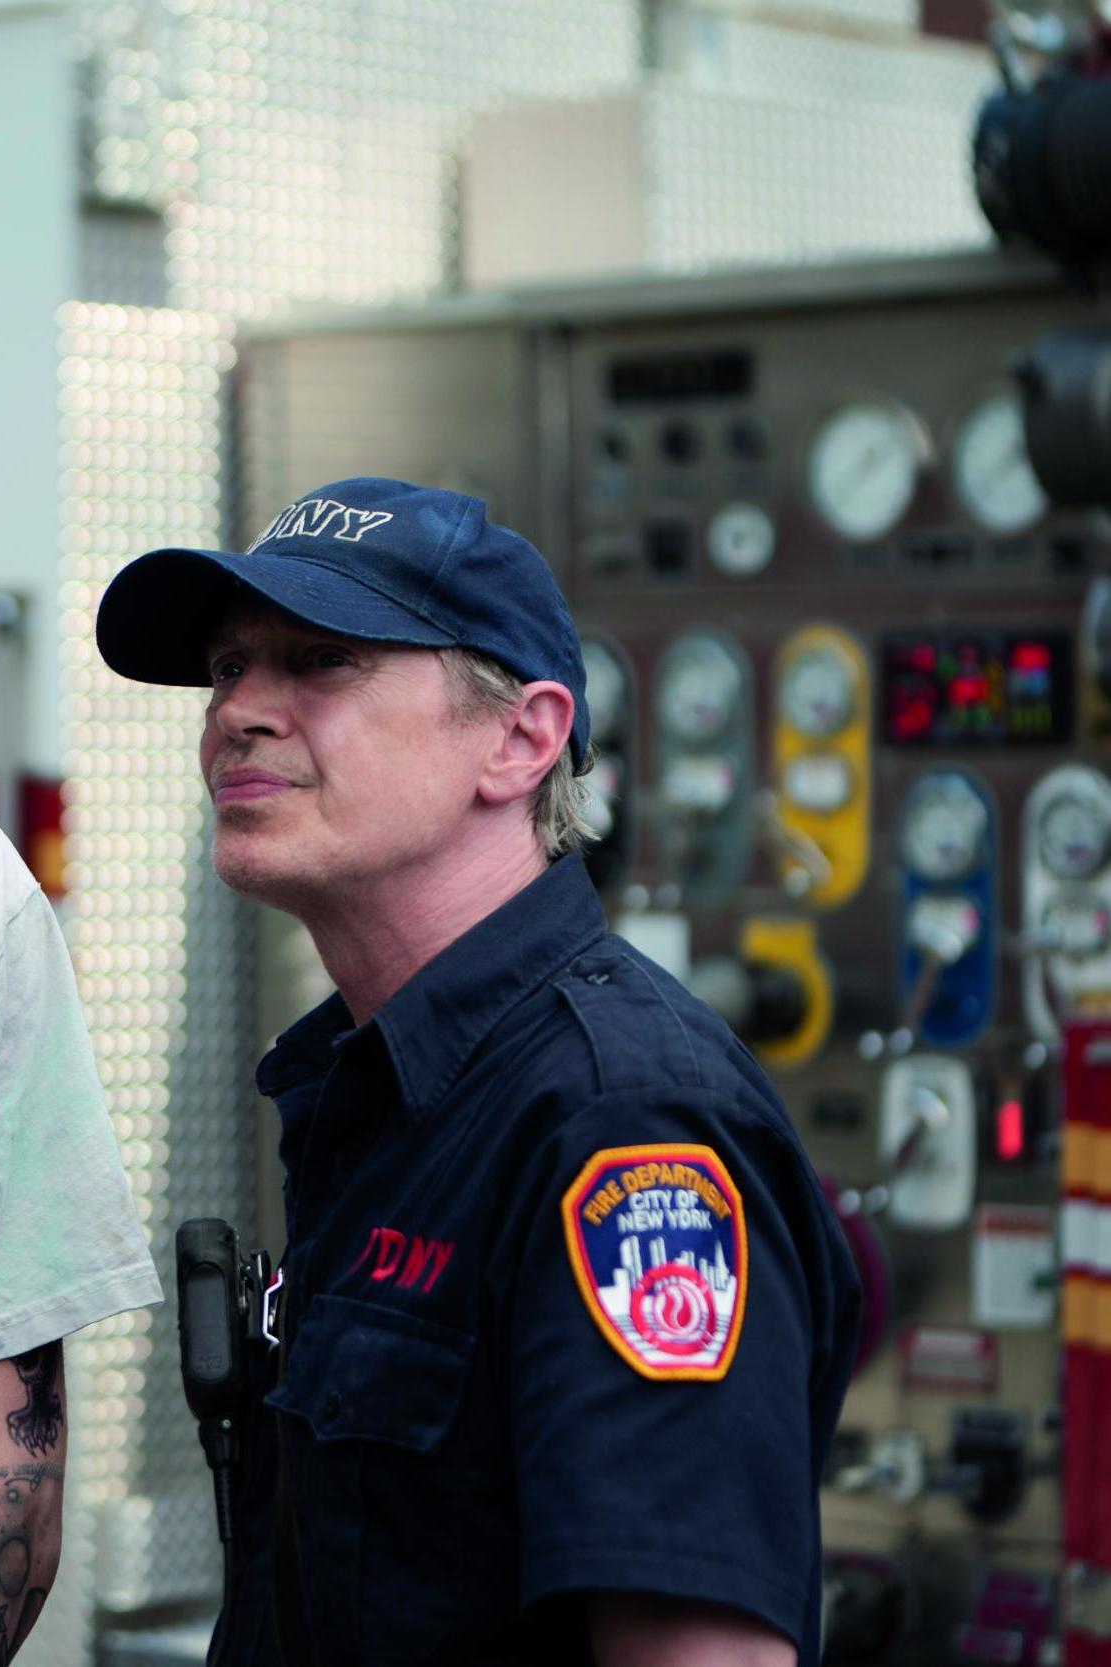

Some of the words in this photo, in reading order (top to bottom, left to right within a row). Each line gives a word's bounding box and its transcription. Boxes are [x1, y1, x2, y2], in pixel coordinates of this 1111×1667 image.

[247, 499, 394, 555] NY
[583, 1180, 626, 1226] FIRE
[628, 1190, 673, 1212] CITY
[675, 1190, 701, 1210] OF
[617, 1209, 665, 1234] NEW
[666, 1208, 713, 1231] YORK
